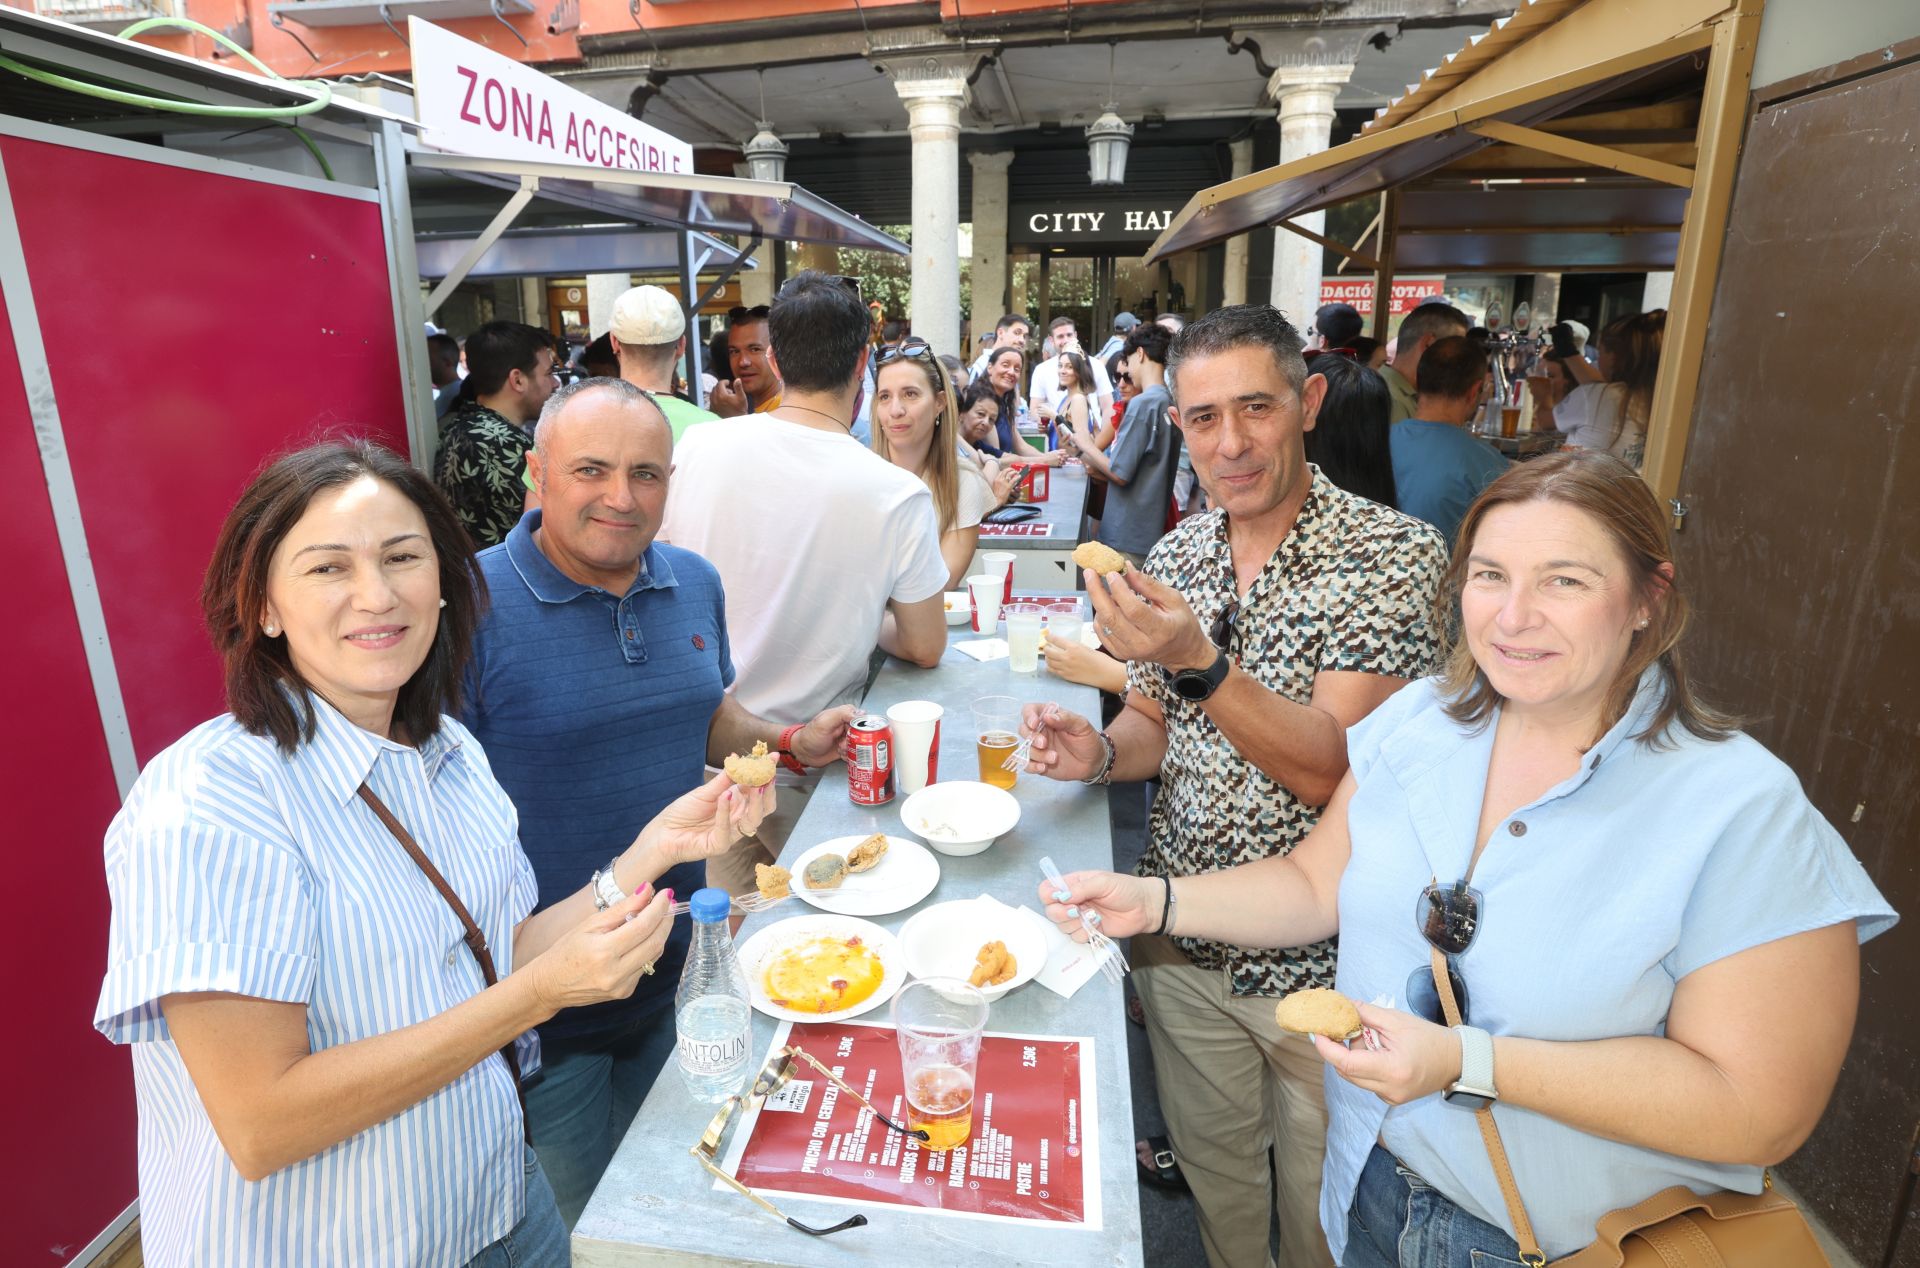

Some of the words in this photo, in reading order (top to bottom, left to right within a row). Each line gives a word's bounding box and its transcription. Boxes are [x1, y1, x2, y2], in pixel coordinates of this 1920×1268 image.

[457, 65, 555, 149] ZONA
[1030, 212, 1104, 232] CITY
[1124, 211, 1172, 230] HAL
[836, 1036, 854, 1057] 3,50€
[1022, 1045, 1037, 1067] 2,50€
[794, 1086, 810, 1110] Hidalgo
[811, 1121, 829, 1138] CON
[800, 1139, 823, 1173] PINCHO
[898, 1151, 917, 1183] GUISOS
[948, 1145, 967, 1187] RACIONES
[1016, 1161, 1032, 1195] POSTRE
